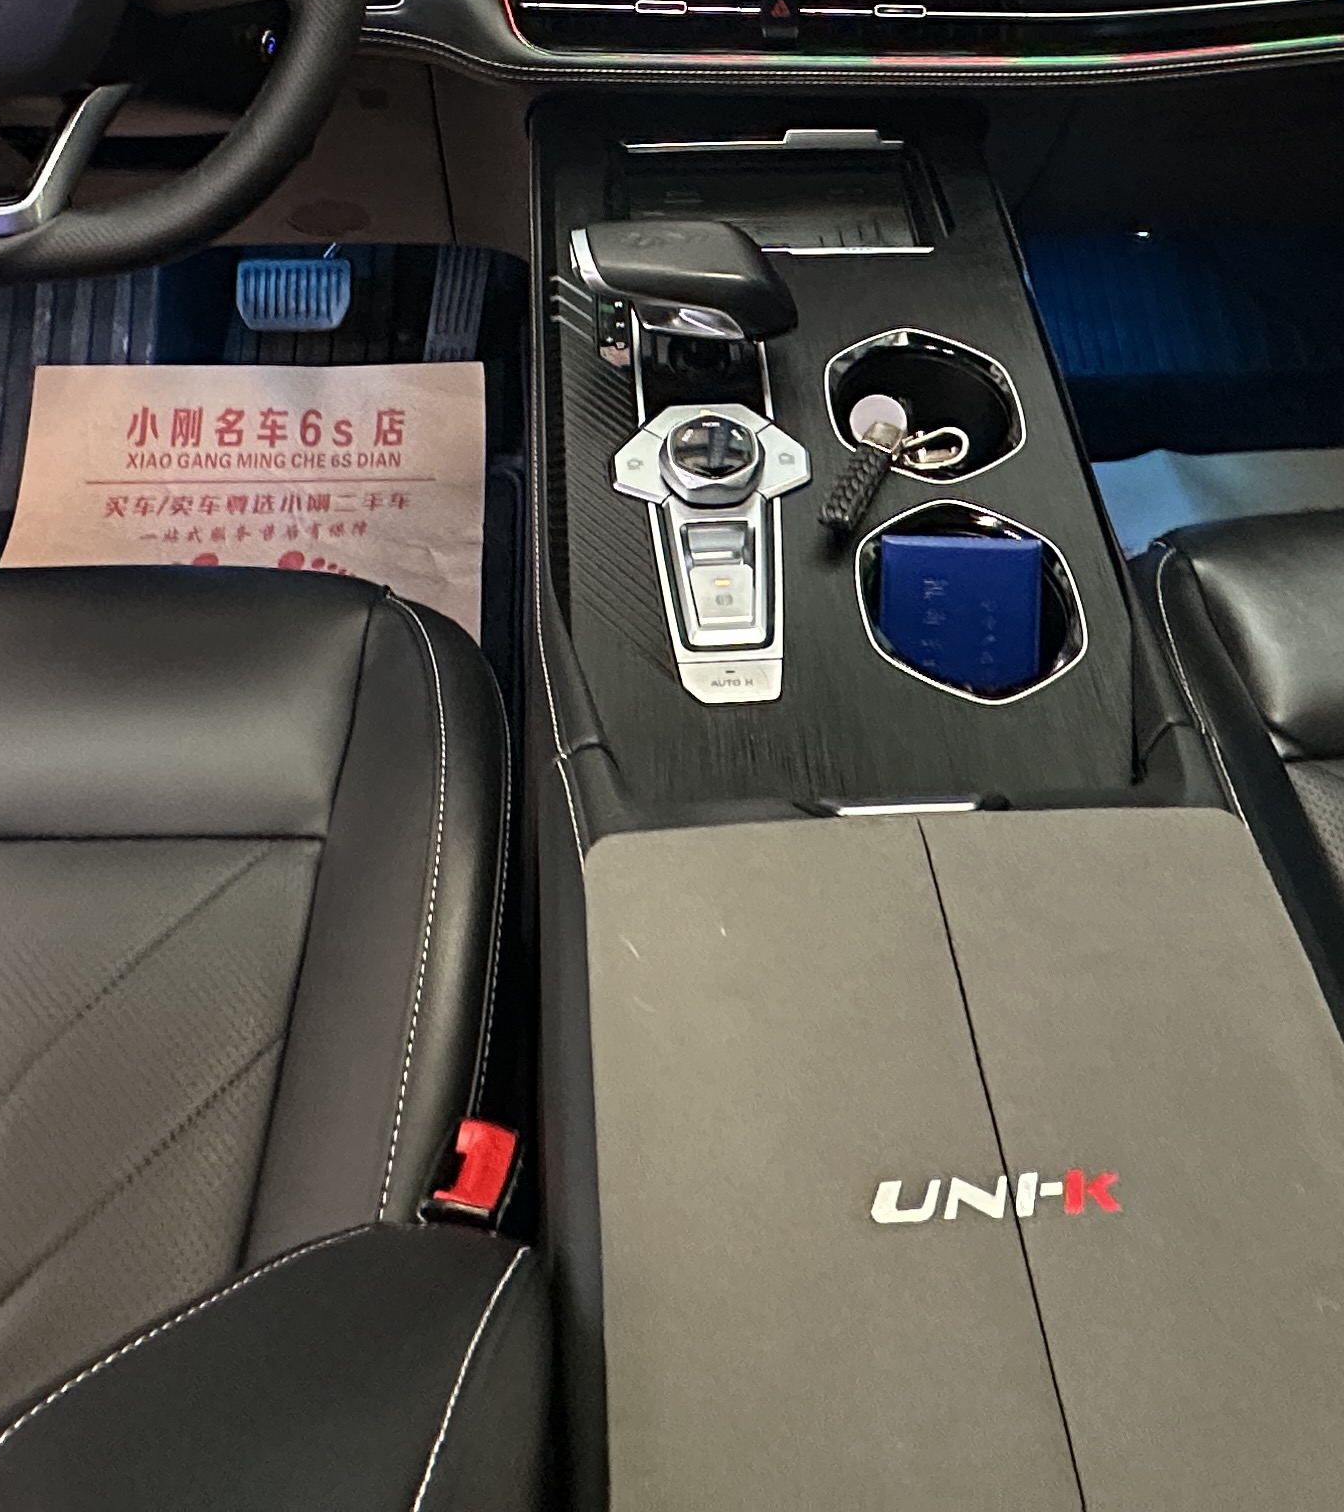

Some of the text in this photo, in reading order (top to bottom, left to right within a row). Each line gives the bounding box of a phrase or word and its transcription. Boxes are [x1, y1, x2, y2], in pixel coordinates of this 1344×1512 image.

[126, 450, 402, 470] XIAO GANG MING CHE 6S DIAN
[711, 679, 741, 687] AUTO
[870, 1167, 1122, 1224] UNI-K
